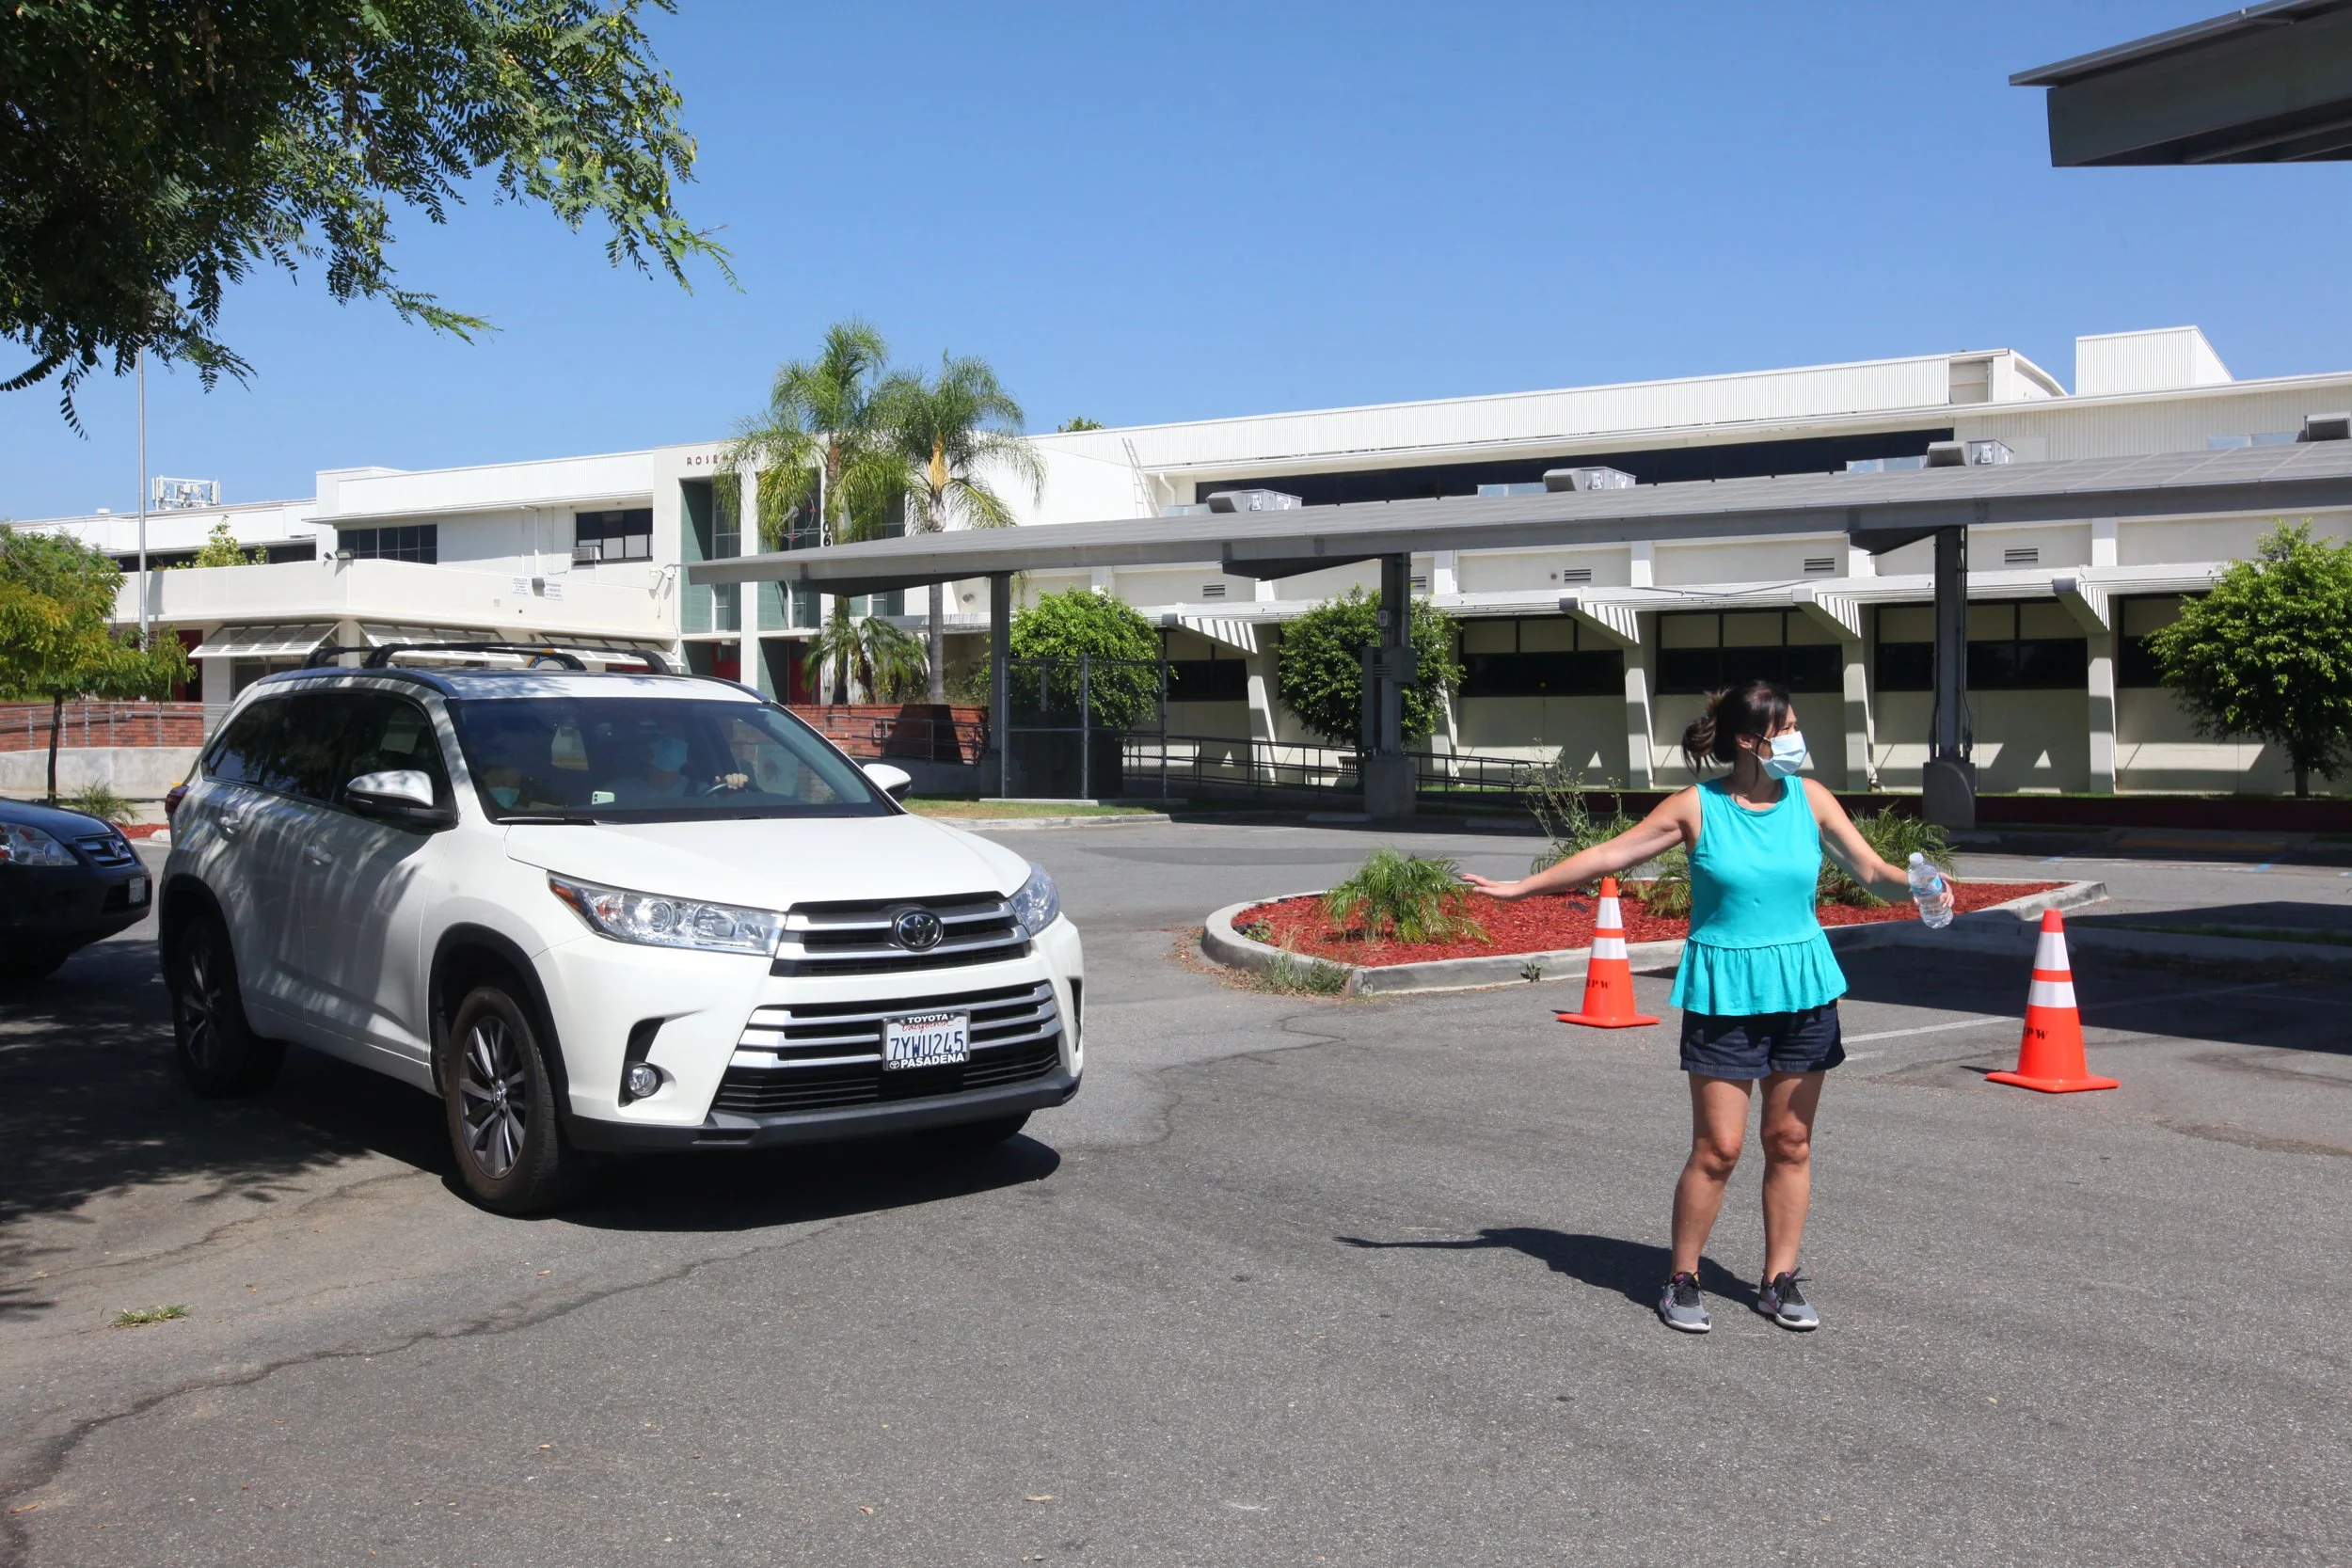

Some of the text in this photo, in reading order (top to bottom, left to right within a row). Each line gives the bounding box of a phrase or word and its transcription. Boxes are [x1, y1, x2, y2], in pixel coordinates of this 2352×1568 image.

[907, 1013, 949, 1024] TOYOTA
[890, 1031, 963, 1060] 7YWU245
[900, 1053, 965, 1069] PASADENA
